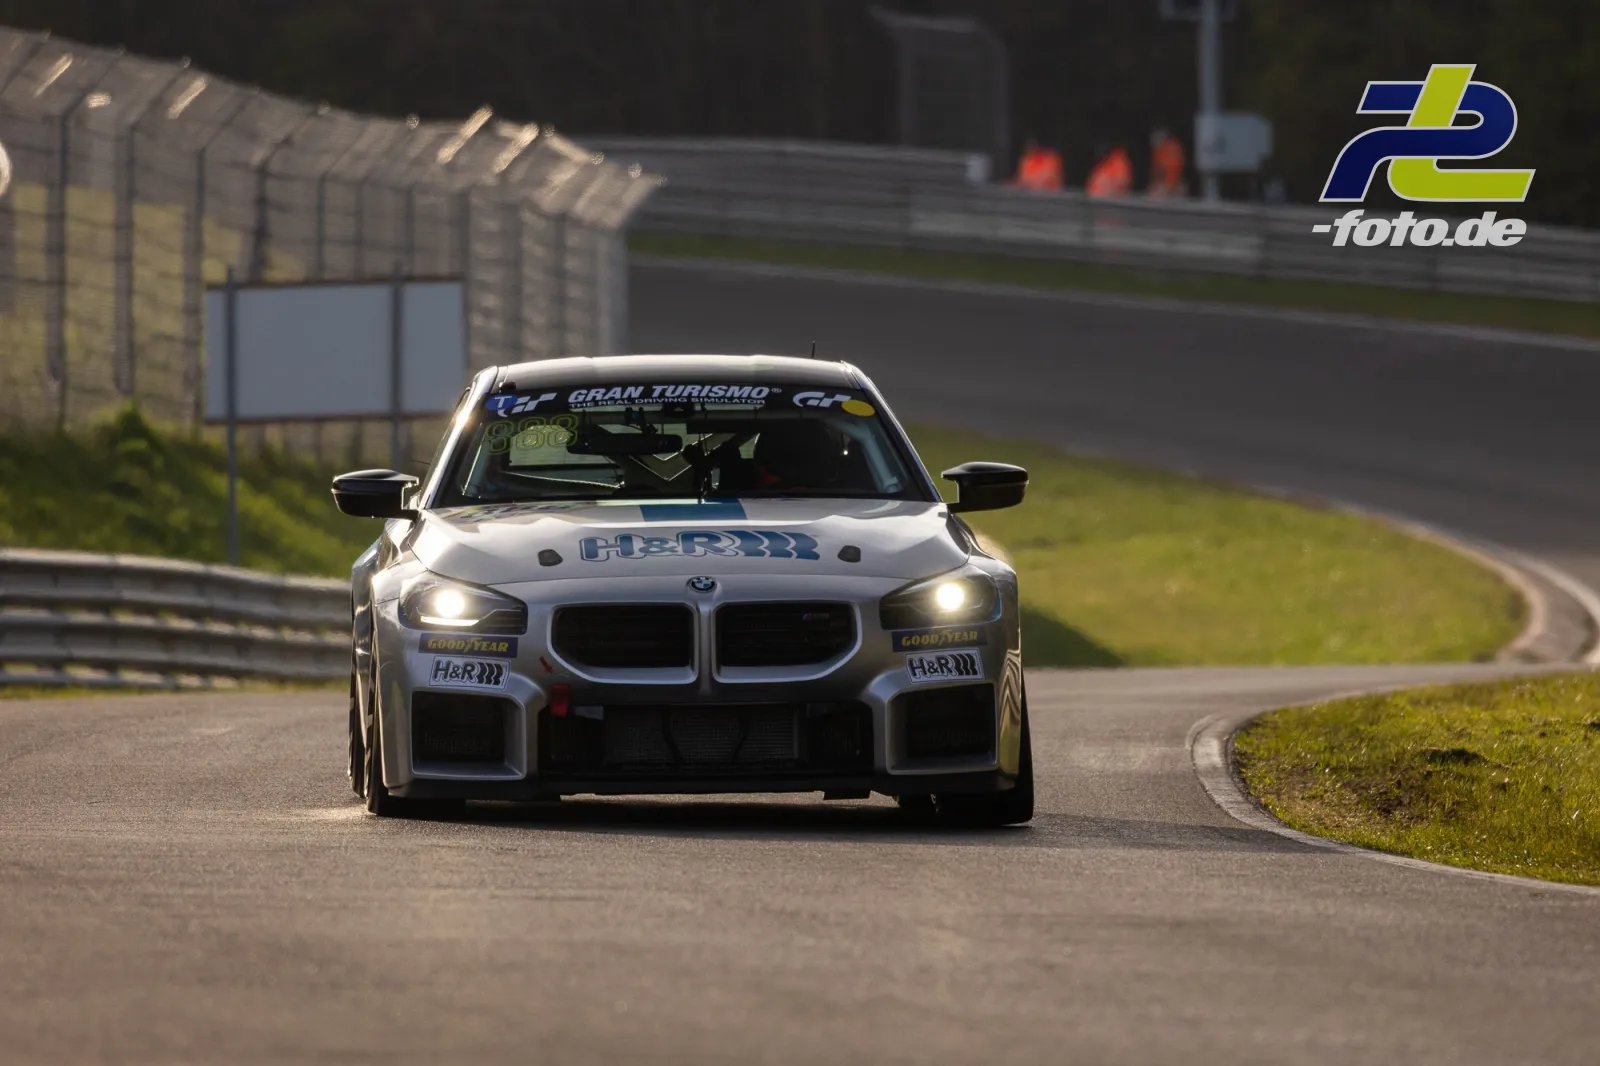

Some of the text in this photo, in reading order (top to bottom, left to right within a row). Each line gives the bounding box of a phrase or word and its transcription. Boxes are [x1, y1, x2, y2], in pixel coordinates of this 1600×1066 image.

[568, 387, 645, 403] GRAN
[484, 413, 579, 454] 888
[579, 531, 740, 562] H&R
[432, 659, 479, 683] H&R
[906, 655, 957, 678] H&R
